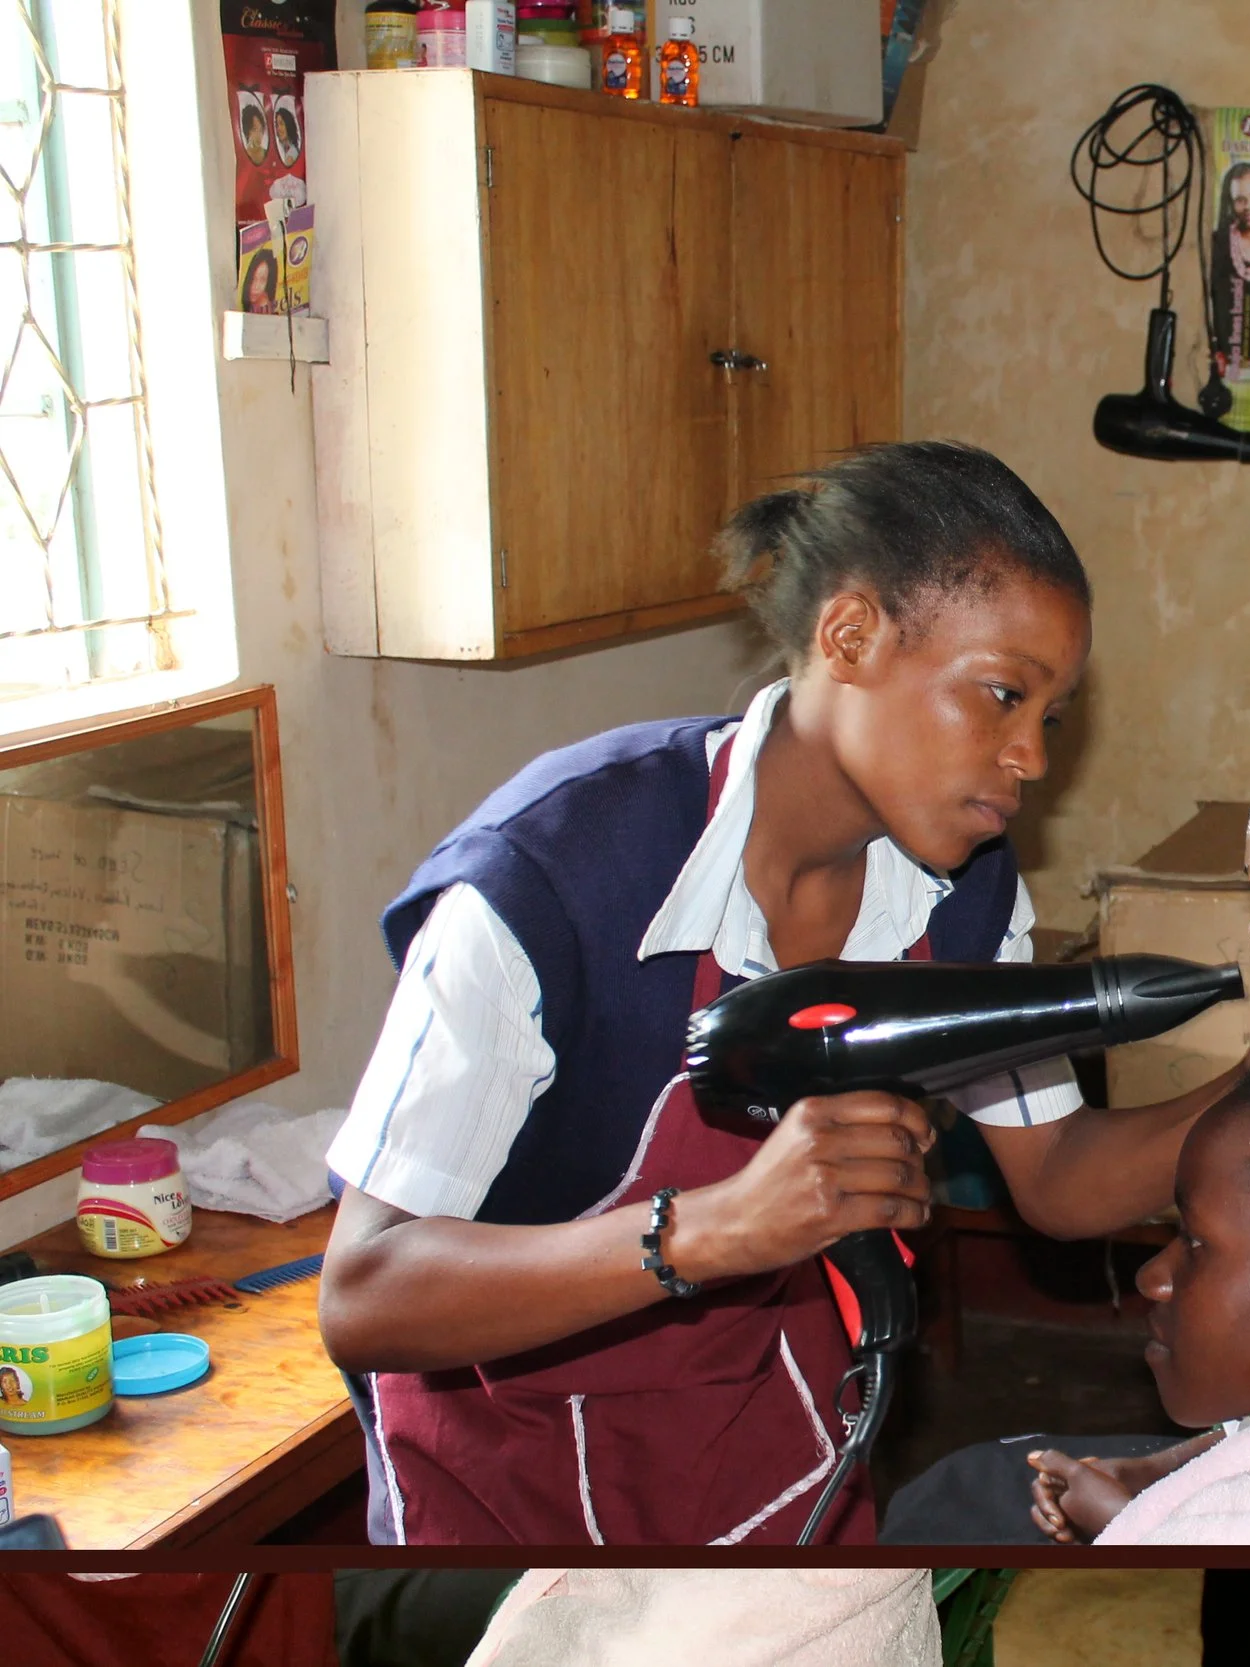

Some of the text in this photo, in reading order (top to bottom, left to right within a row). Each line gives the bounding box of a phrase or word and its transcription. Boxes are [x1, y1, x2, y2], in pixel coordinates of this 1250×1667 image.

[712, 45, 734, 63] CM
[154, 1192, 175, 1204] Nice
[0, 1346, 49, 1364] RIS
